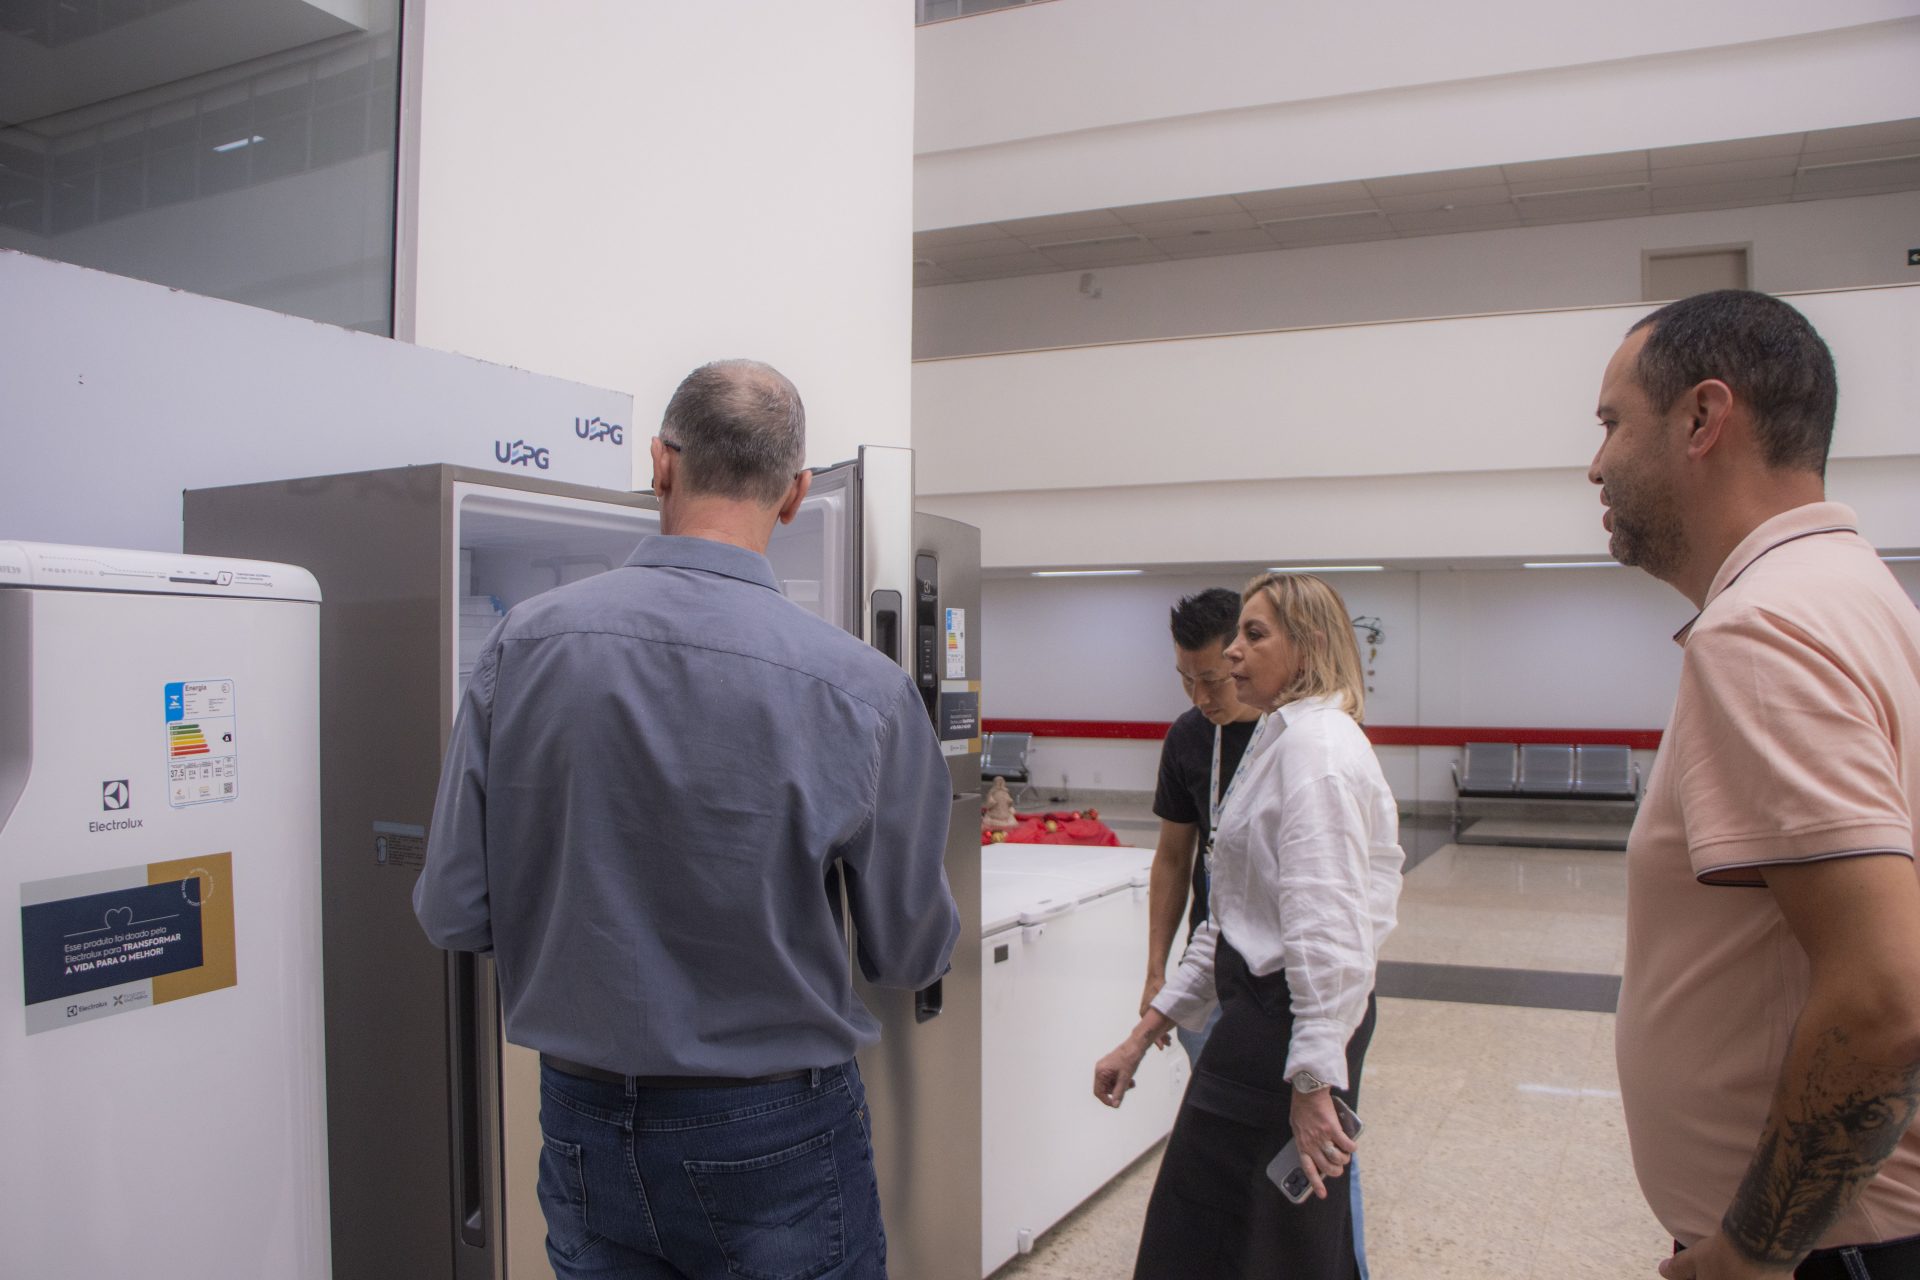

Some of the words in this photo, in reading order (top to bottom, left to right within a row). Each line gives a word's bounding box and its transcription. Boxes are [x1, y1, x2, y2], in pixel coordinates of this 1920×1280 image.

[575, 416, 623, 445] UEPG
[495, 439, 550, 470] UEPG
[185, 684, 207, 692] Energia
[170, 768, 185, 778] 37.5
[88, 817, 143, 833] Electrolux
[64, 944, 82, 953] Esse
[83, 936, 114, 950] produto
[115, 934, 125, 943] foi
[125, 930, 150, 941] doado
[150, 926, 167, 938] pela
[65, 951, 102, 964] Electrolux
[103, 947, 122, 958] para
[122, 933, 182, 952] TRANSFORMAR
[65, 967, 73, 975] A
[73, 962, 95, 972] VIDA
[96, 957, 119, 968] PARA
[120, 955, 127, 963] O
[128, 947, 164, 961] MELHOR!
[79, 1001, 108, 1013] Electrolux
